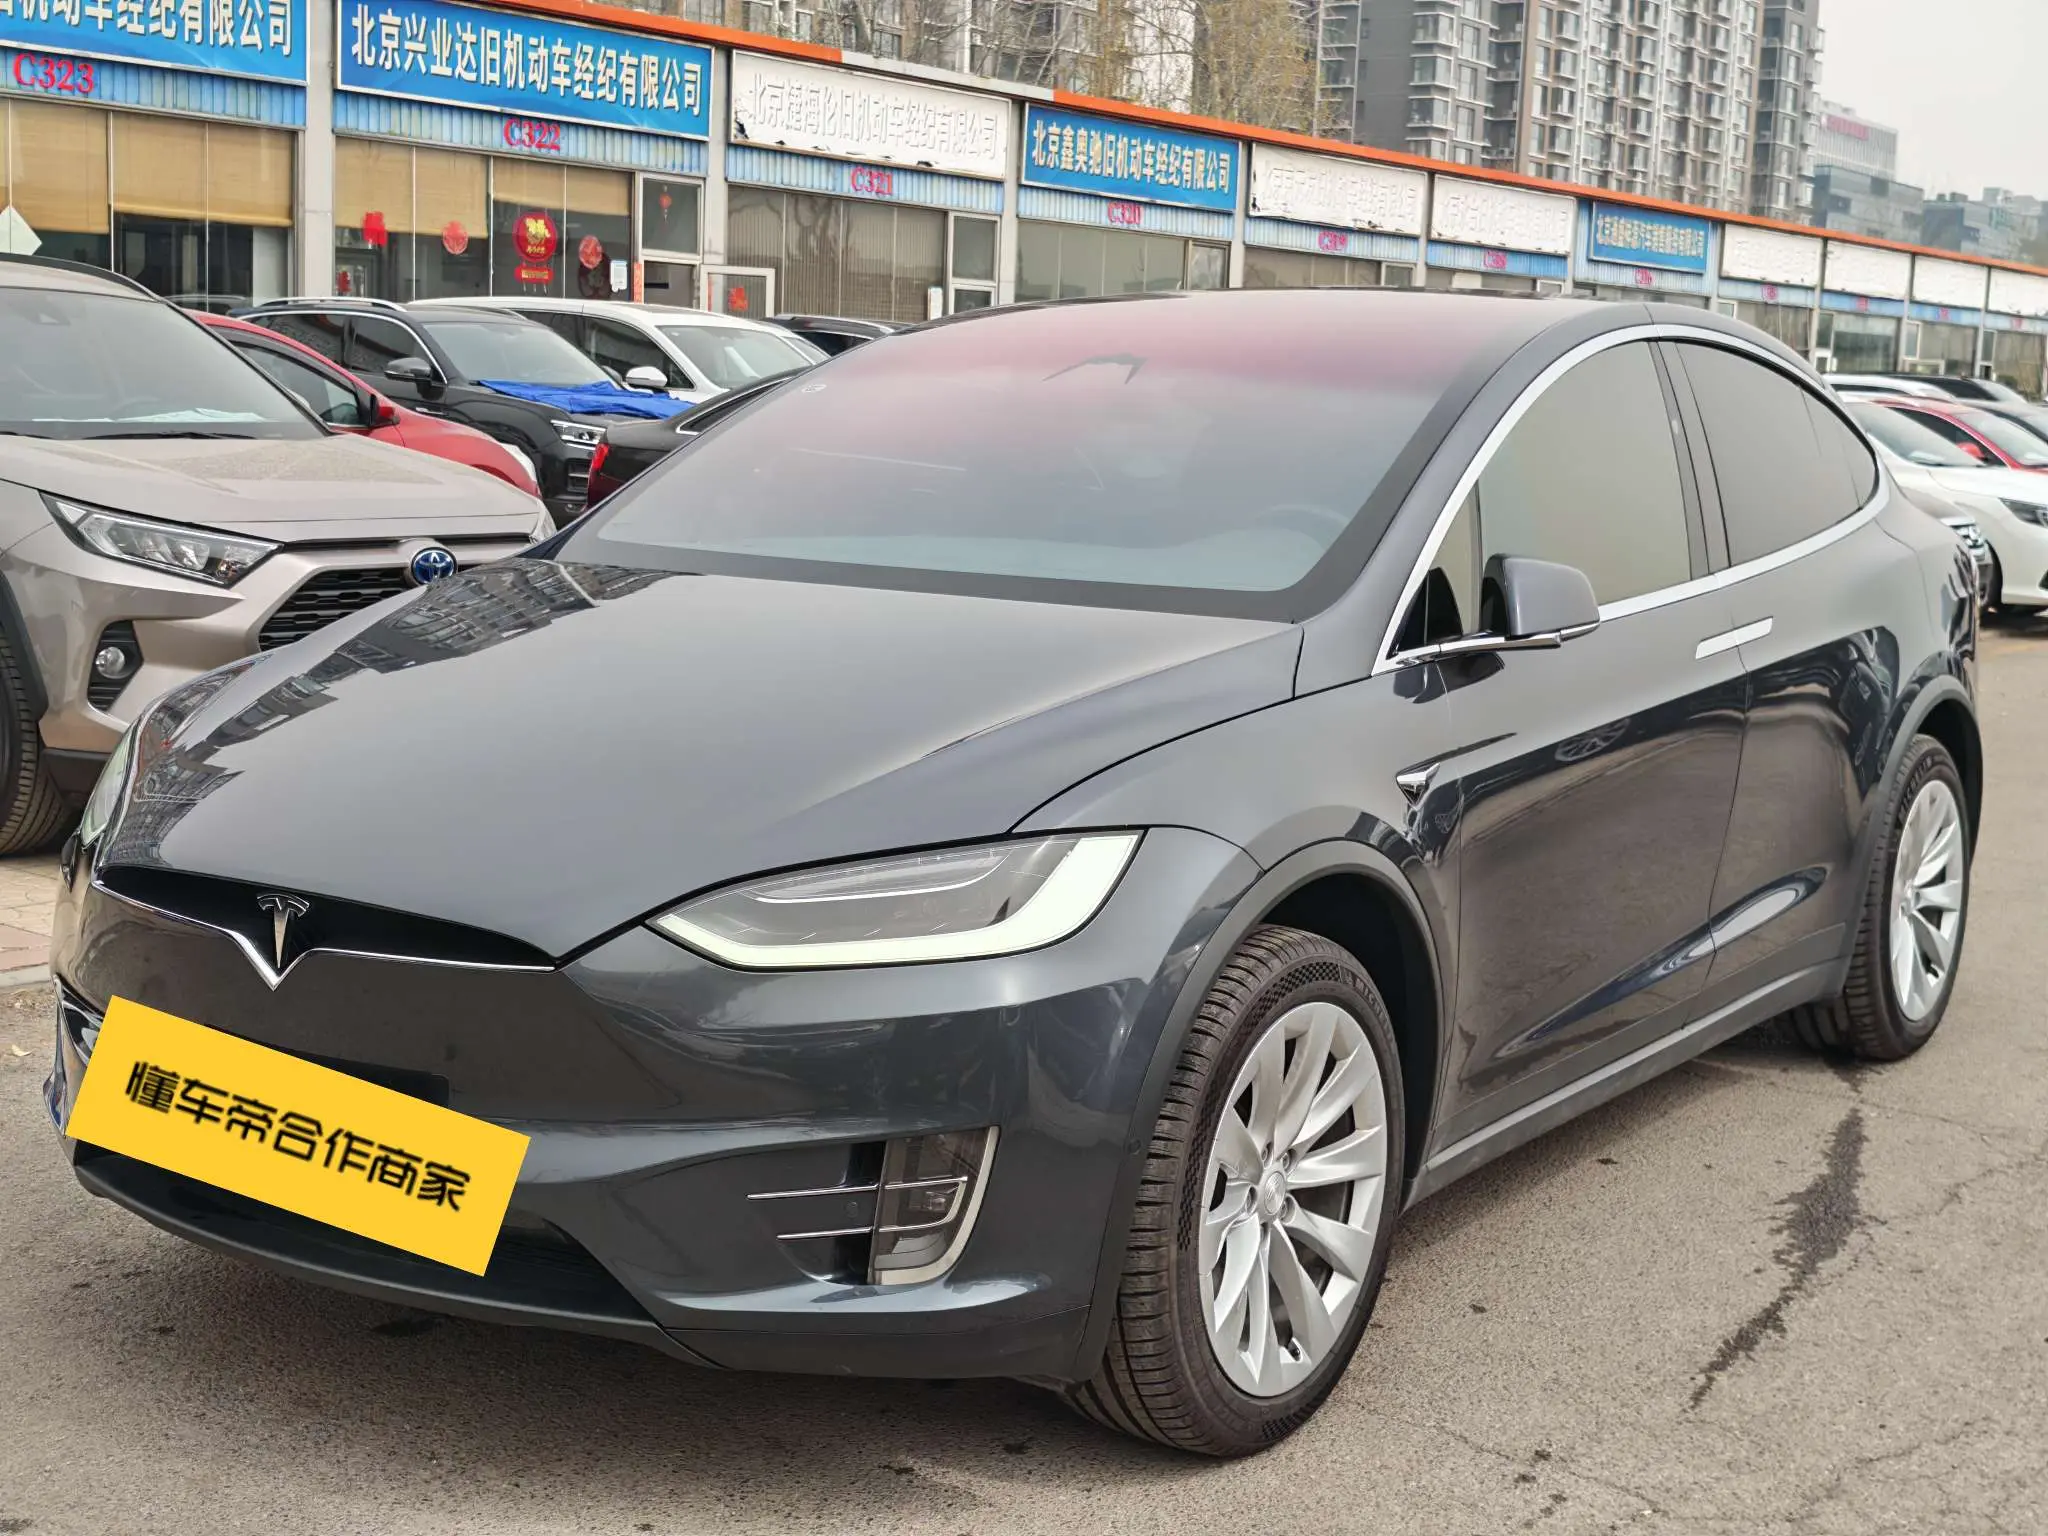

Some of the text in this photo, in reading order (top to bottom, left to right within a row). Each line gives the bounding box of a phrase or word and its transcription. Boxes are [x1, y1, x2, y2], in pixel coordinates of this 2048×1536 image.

[13, 52, 95, 94] C323
[351, 3, 703, 116] 北京兴业达旧机动车经纪有限公司
[503, 117, 562, 151] C322
[851, 166, 894, 196] C321
